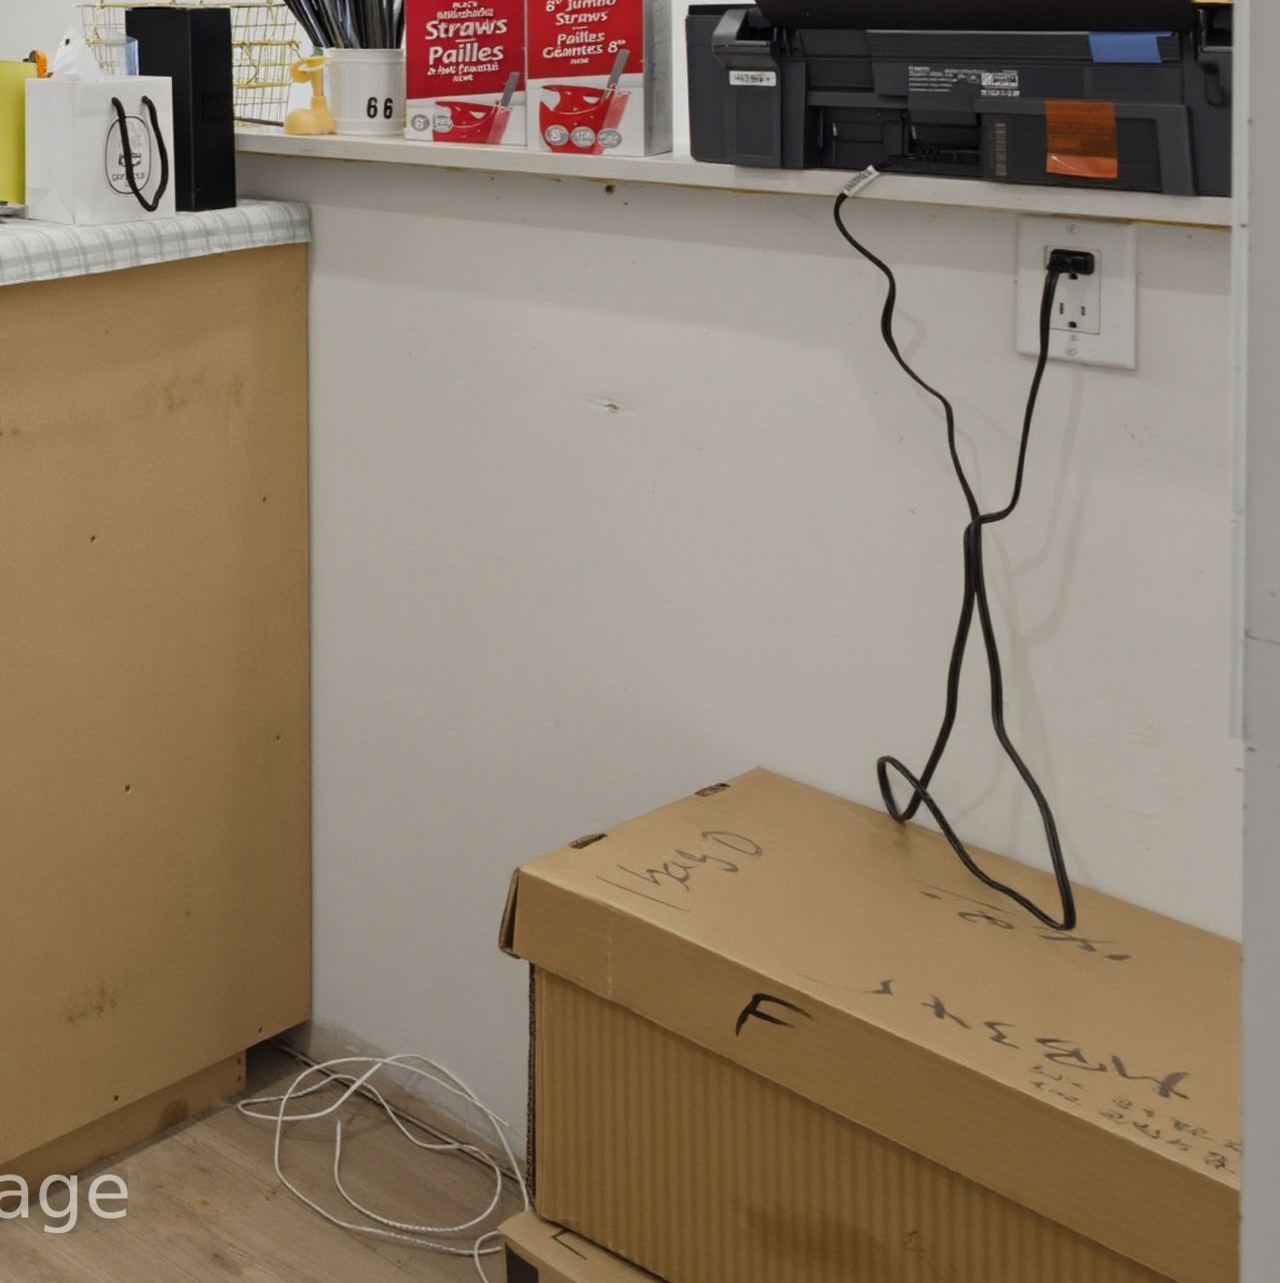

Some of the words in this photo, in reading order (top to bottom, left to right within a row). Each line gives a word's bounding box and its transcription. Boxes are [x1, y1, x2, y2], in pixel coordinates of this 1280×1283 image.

[555, 10, 608, 26] Straws
[425, 19, 508, 40] Straws
[557, 31, 605, 45] Pailles
[428, 43, 504, 65] Pailles
